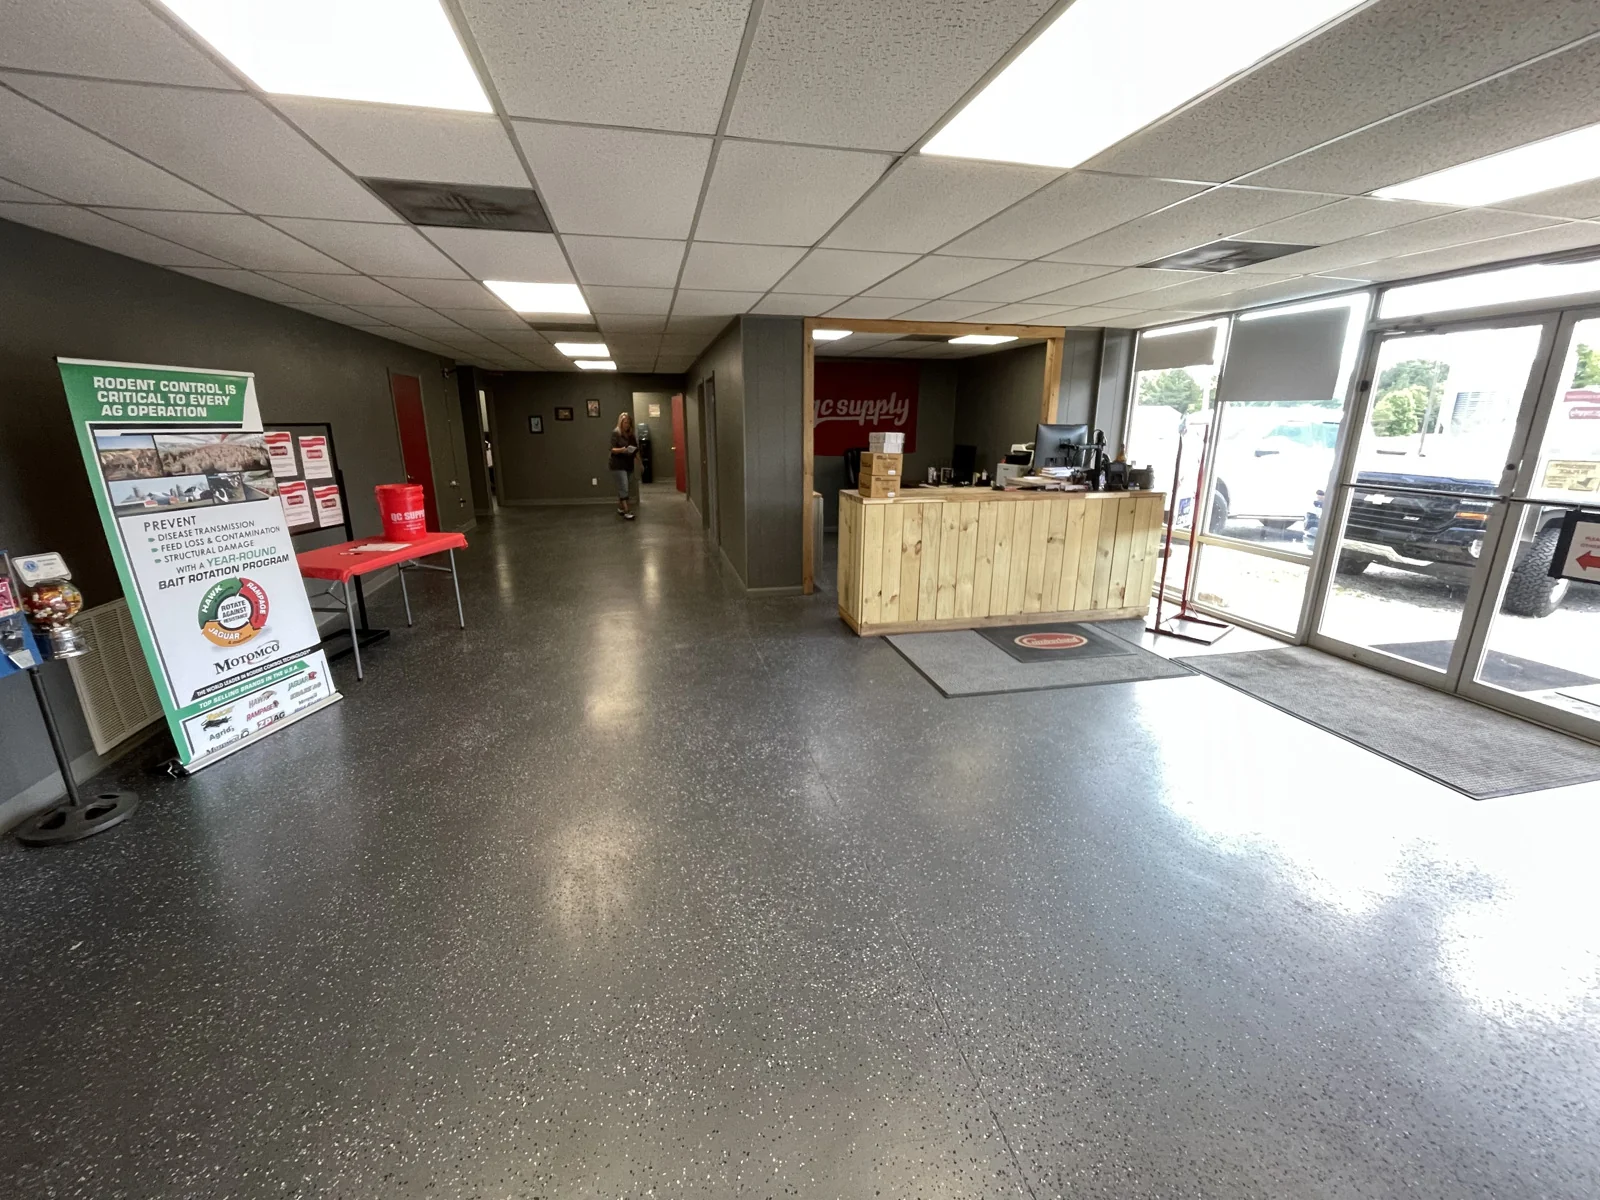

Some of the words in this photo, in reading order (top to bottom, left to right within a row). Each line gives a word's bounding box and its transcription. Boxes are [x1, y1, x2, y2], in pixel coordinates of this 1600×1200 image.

[93, 376, 156, 391] RODENT
[160, 380, 223, 394] CONTROL
[225, 384, 237, 395] IS
[97, 391, 165, 404] CRITICAL
[168, 393, 186, 405] TO
[189, 394, 231, 406] EVERY
[836, 392, 909, 426] supply
[101, 405, 123, 416] AG
[127, 405, 207, 417] OPERATION
[144, 515, 196, 532] PREVENT
[390, 513, 403, 522] QC
[403, 509, 425, 520] SUPP
[158, 529, 193, 542] DISEASE
[195, 520, 255, 536] TRANSMISSION
[161, 542, 182, 552] FEED
[185, 538, 205, 548] LOSS
[215, 526, 280, 543] CONTAMINATION
[164, 546, 217, 563] STRUCTURAL
[218, 540, 254, 552] DAMAGE
[176, 564, 197, 574] WITH
[206, 546, 277, 567] YEAR-ROUND
[158, 576, 185, 590] BAIT
[188, 564, 240, 584] ROTATION
[242, 554, 290, 571] PROGRAM
[201, 584, 223, 614] HAWK
[221, 600, 246, 611] ROTATE
[246, 582, 267, 614] RAMPAGE
[222, 607, 247, 618] AGAINST
[208, 628, 240, 640] JAGUAR
[196, 689, 206, 697] THE
[206, 682, 224, 693] WORLD
[263, 659, 283, 670] CONTROL
[198, 699, 213, 708] TOP
[213, 688, 240, 703] SELLING
[240, 678, 265, 692] BRANDS
[272, 670, 283, 678] THE
[246, 703, 274, 722] RAMPAGE
